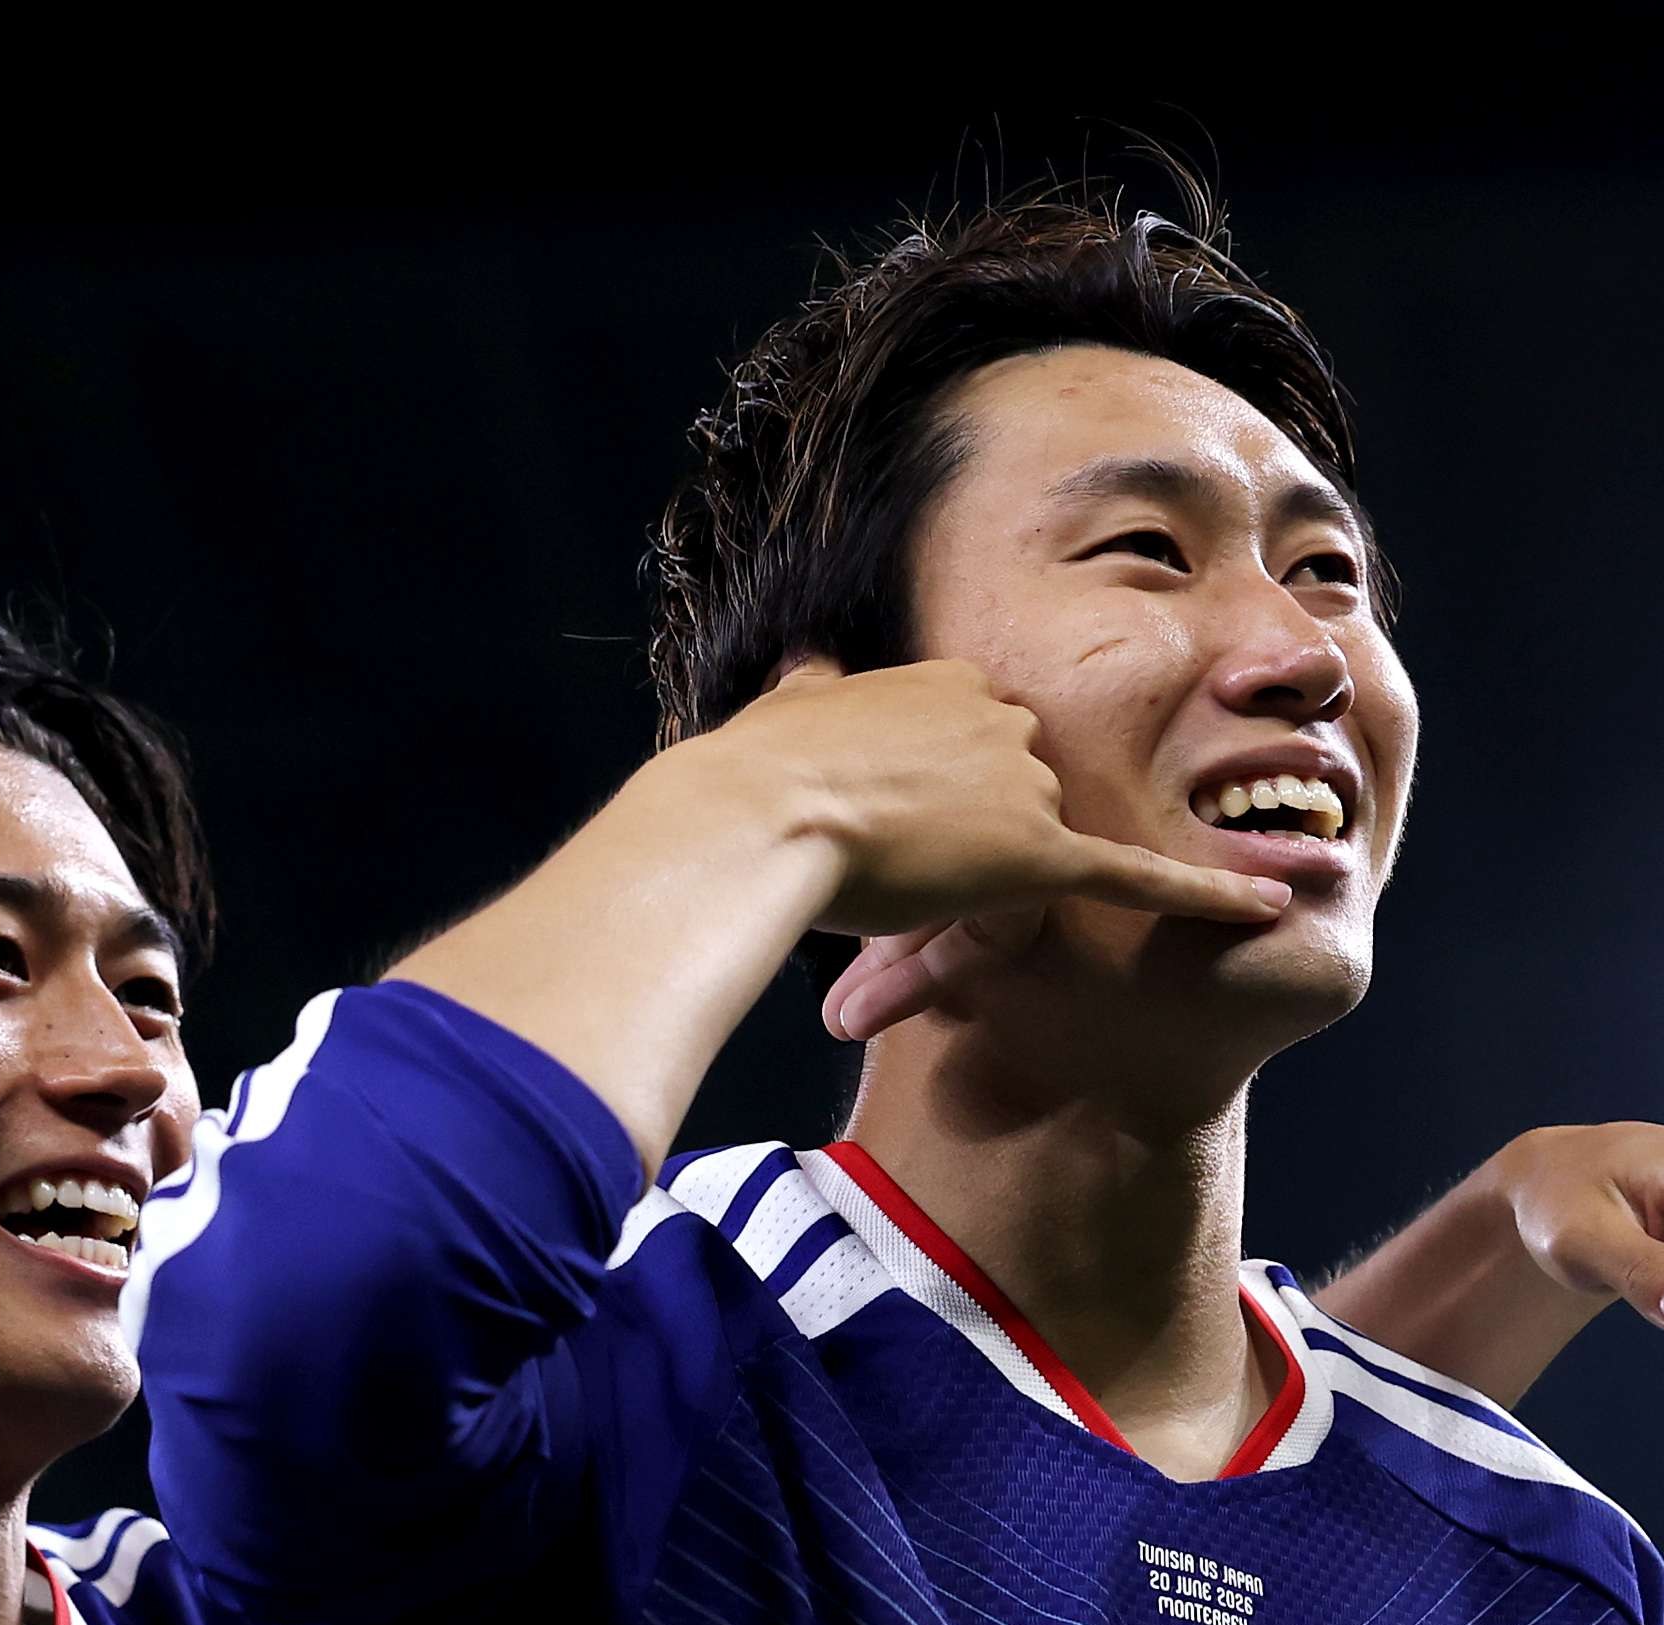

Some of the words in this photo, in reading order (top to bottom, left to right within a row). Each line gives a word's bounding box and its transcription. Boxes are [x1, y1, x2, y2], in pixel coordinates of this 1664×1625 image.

[1138, 1540, 1194, 1573] TUNISIA
[1222, 1565, 1264, 1597] JAPAN
[1149, 1570, 1170, 1591] 20
[1176, 1575, 1212, 1601] JUNE
[1216, 1587, 1253, 1615] 2026
